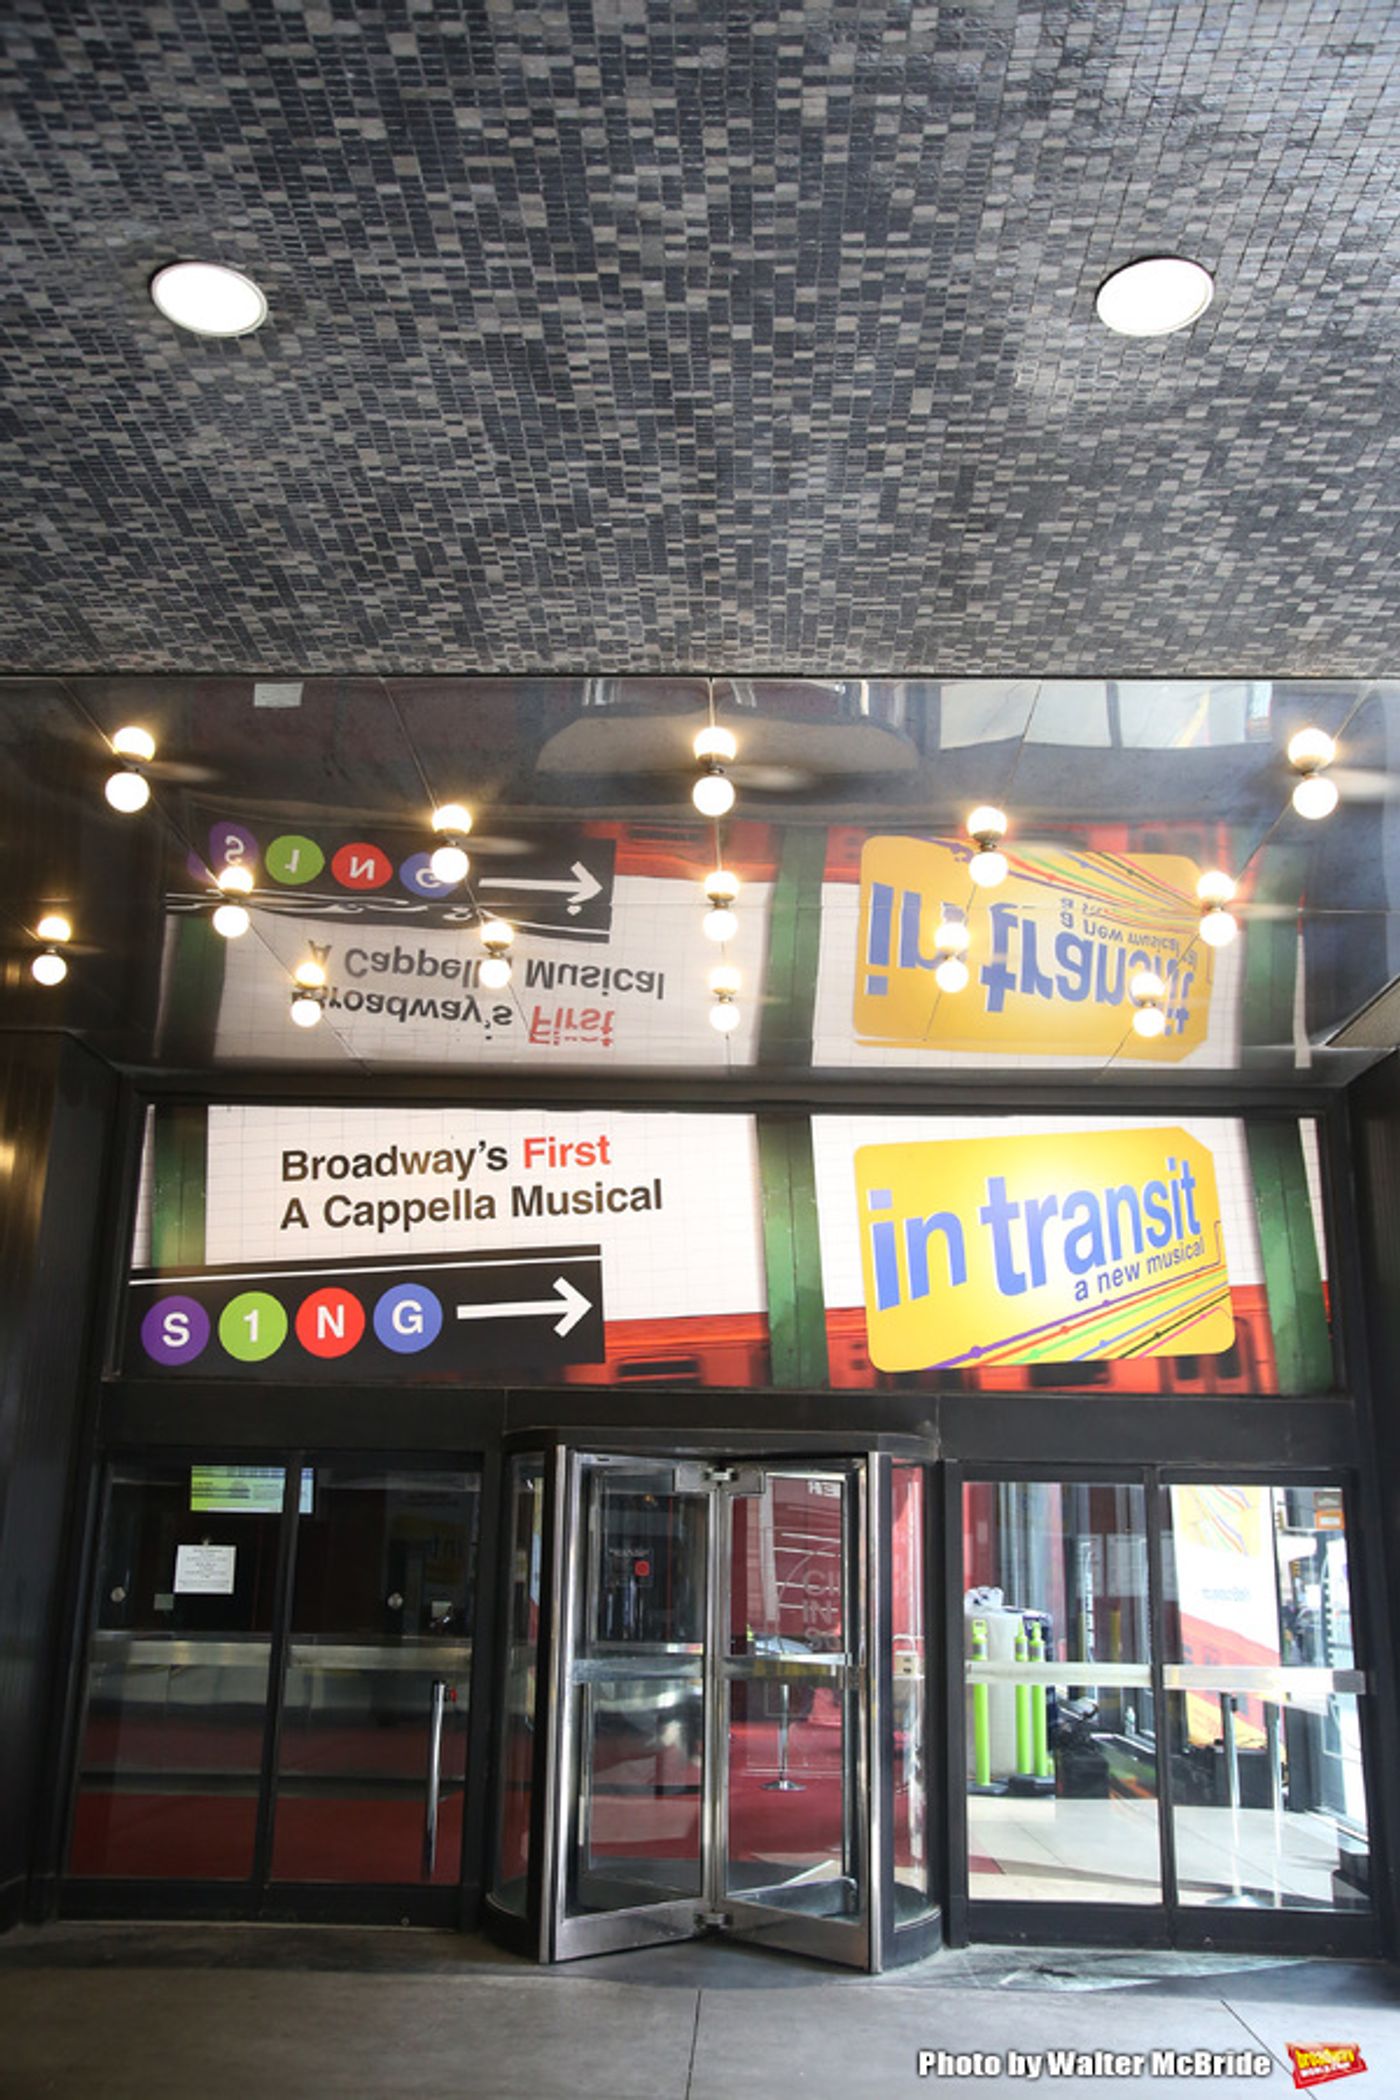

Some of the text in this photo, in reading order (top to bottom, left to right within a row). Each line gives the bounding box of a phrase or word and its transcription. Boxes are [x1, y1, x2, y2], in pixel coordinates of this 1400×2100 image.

[281, 1134, 611, 1184] Broadway's First
[280, 1179, 662, 1233] A Cappella Musical
[867, 1156, 1200, 1312] in transit
[1074, 1236, 1206, 1302] a new musical
